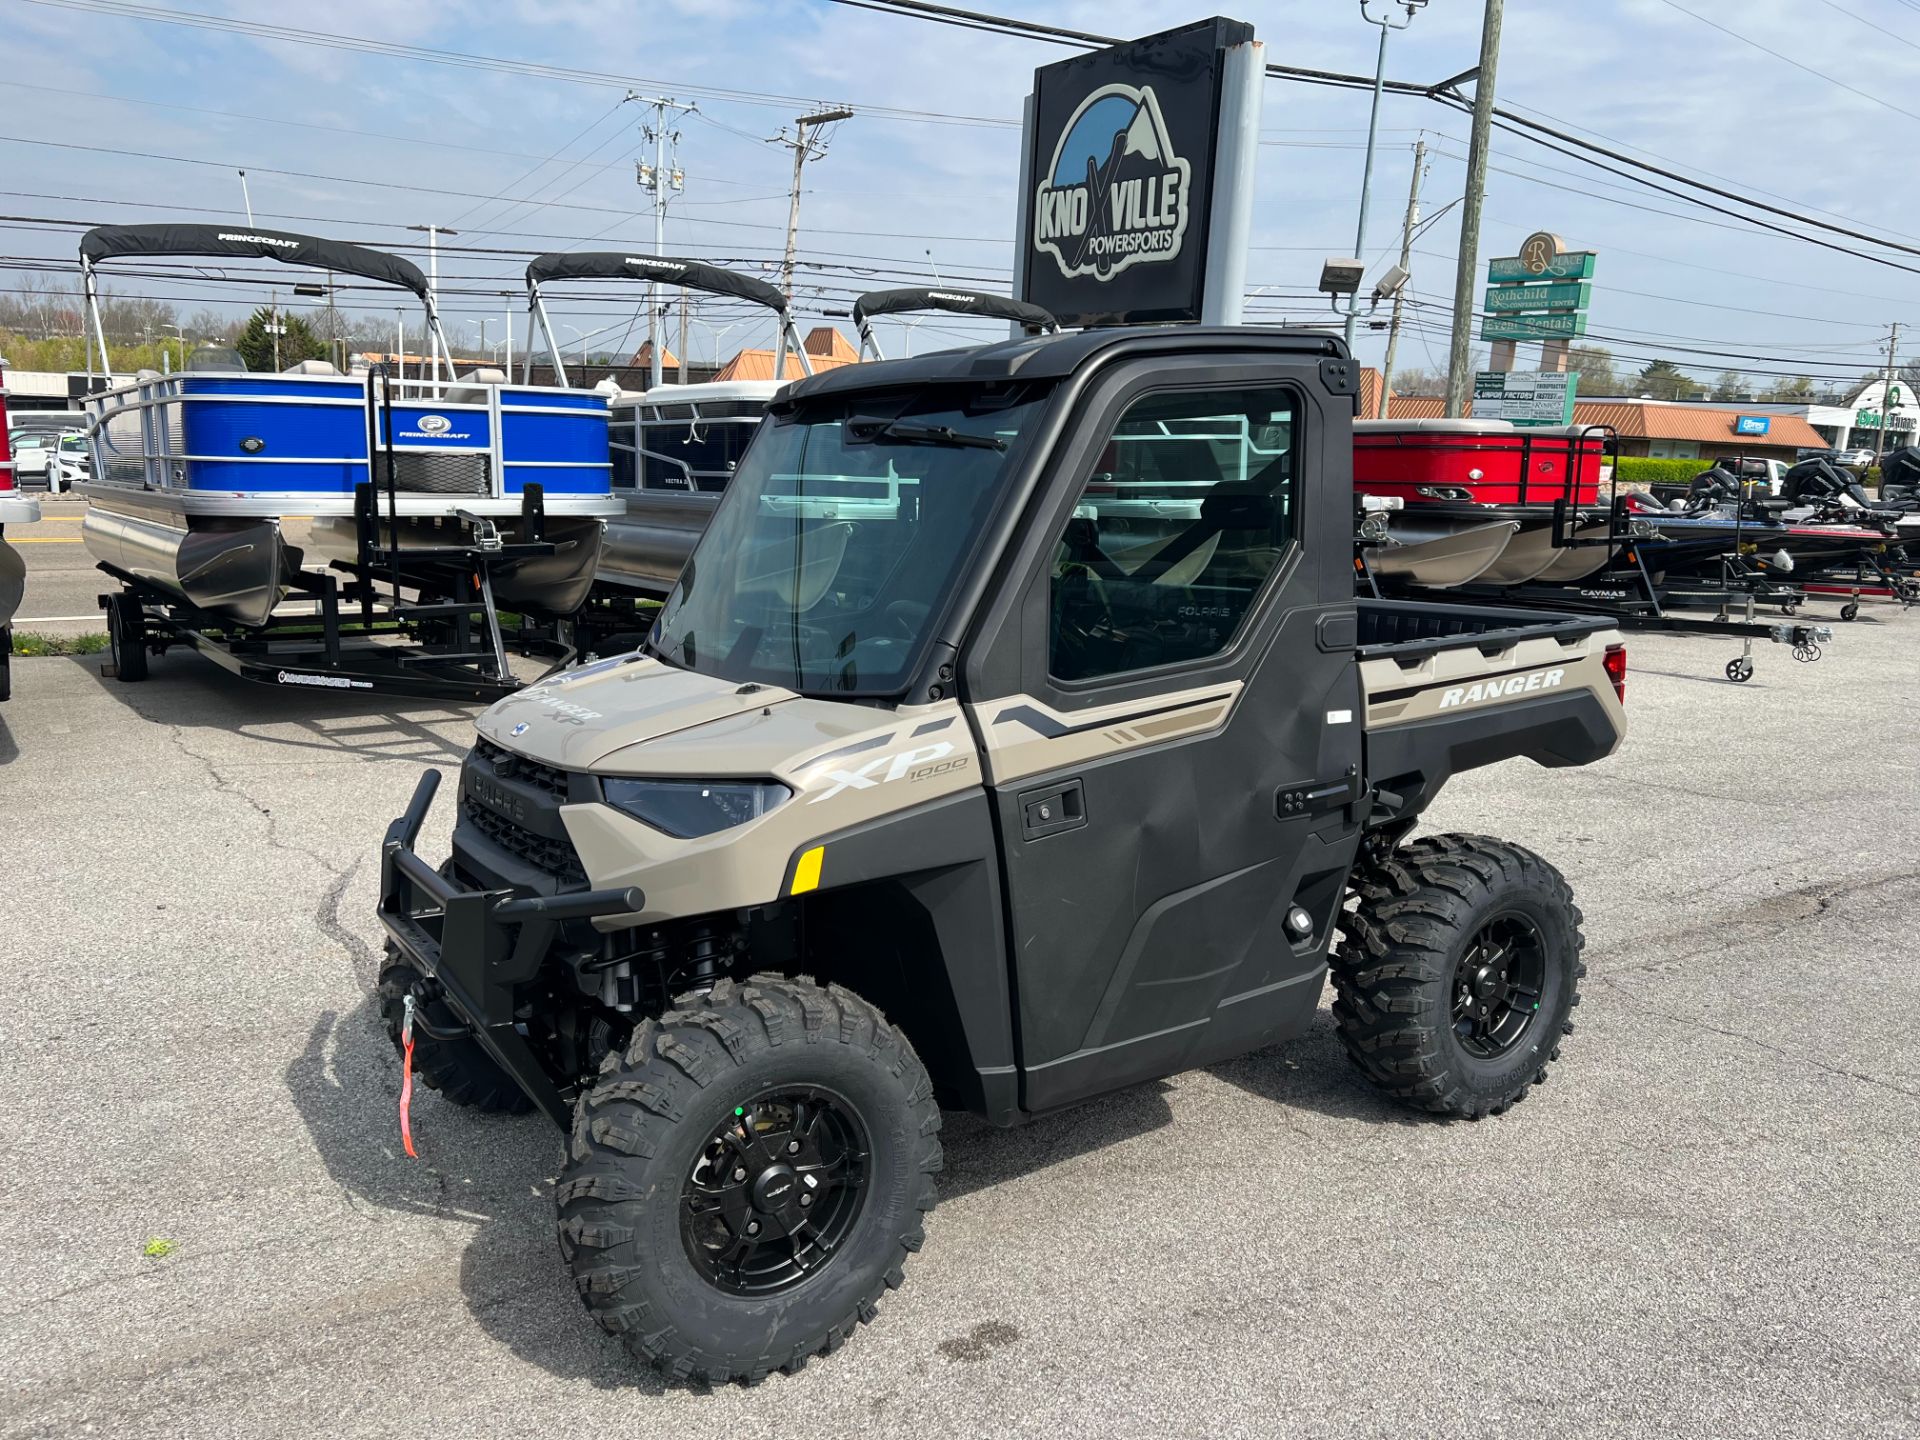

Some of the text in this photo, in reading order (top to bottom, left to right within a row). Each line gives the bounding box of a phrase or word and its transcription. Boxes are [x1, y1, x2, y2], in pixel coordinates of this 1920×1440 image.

[1039, 171, 1180, 240] KNOXVILLE
[217, 233, 300, 248] PRINCECRAFT
[1088, 229, 1172, 255] POWERSPORTS
[625, 257, 688, 271] PRINCECRAFT
[1551, 256, 1583, 267] PLACE
[928, 292, 976, 303] PRINCECRAFT
[1489, 287, 1548, 304] Rothchild
[1551, 299, 1575, 307] CENTER
[1503, 391, 1534, 400] FACTORY
[399, 431, 471, 439] PRINCECRAFT
[1580, 589, 1627, 598] CAYMAS
[1178, 605, 1231, 617] POLARIS
[1438, 668, 1566, 710] RANGER
[541, 710, 586, 727] XP
[806, 740, 955, 805] XP
[910, 757, 969, 780] 1000
